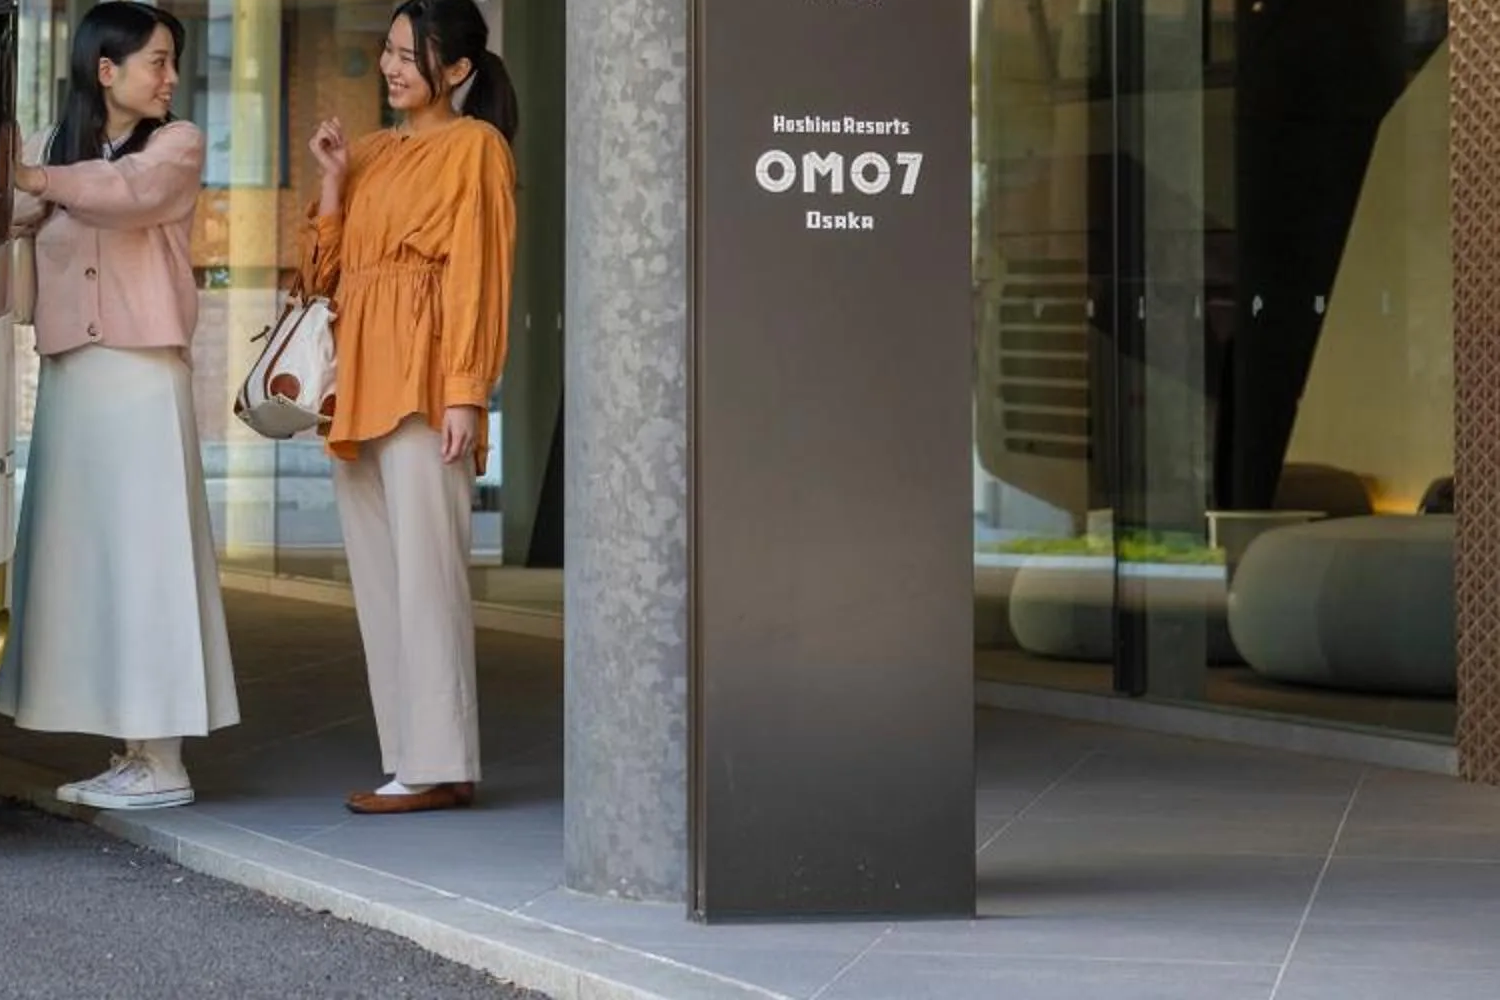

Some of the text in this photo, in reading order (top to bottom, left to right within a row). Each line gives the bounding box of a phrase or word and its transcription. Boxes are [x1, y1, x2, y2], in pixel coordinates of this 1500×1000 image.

[772, 115, 910, 136] Hoshino Resorts
[755, 149, 924, 195] OMO7
[806, 210, 875, 231] Osaka
